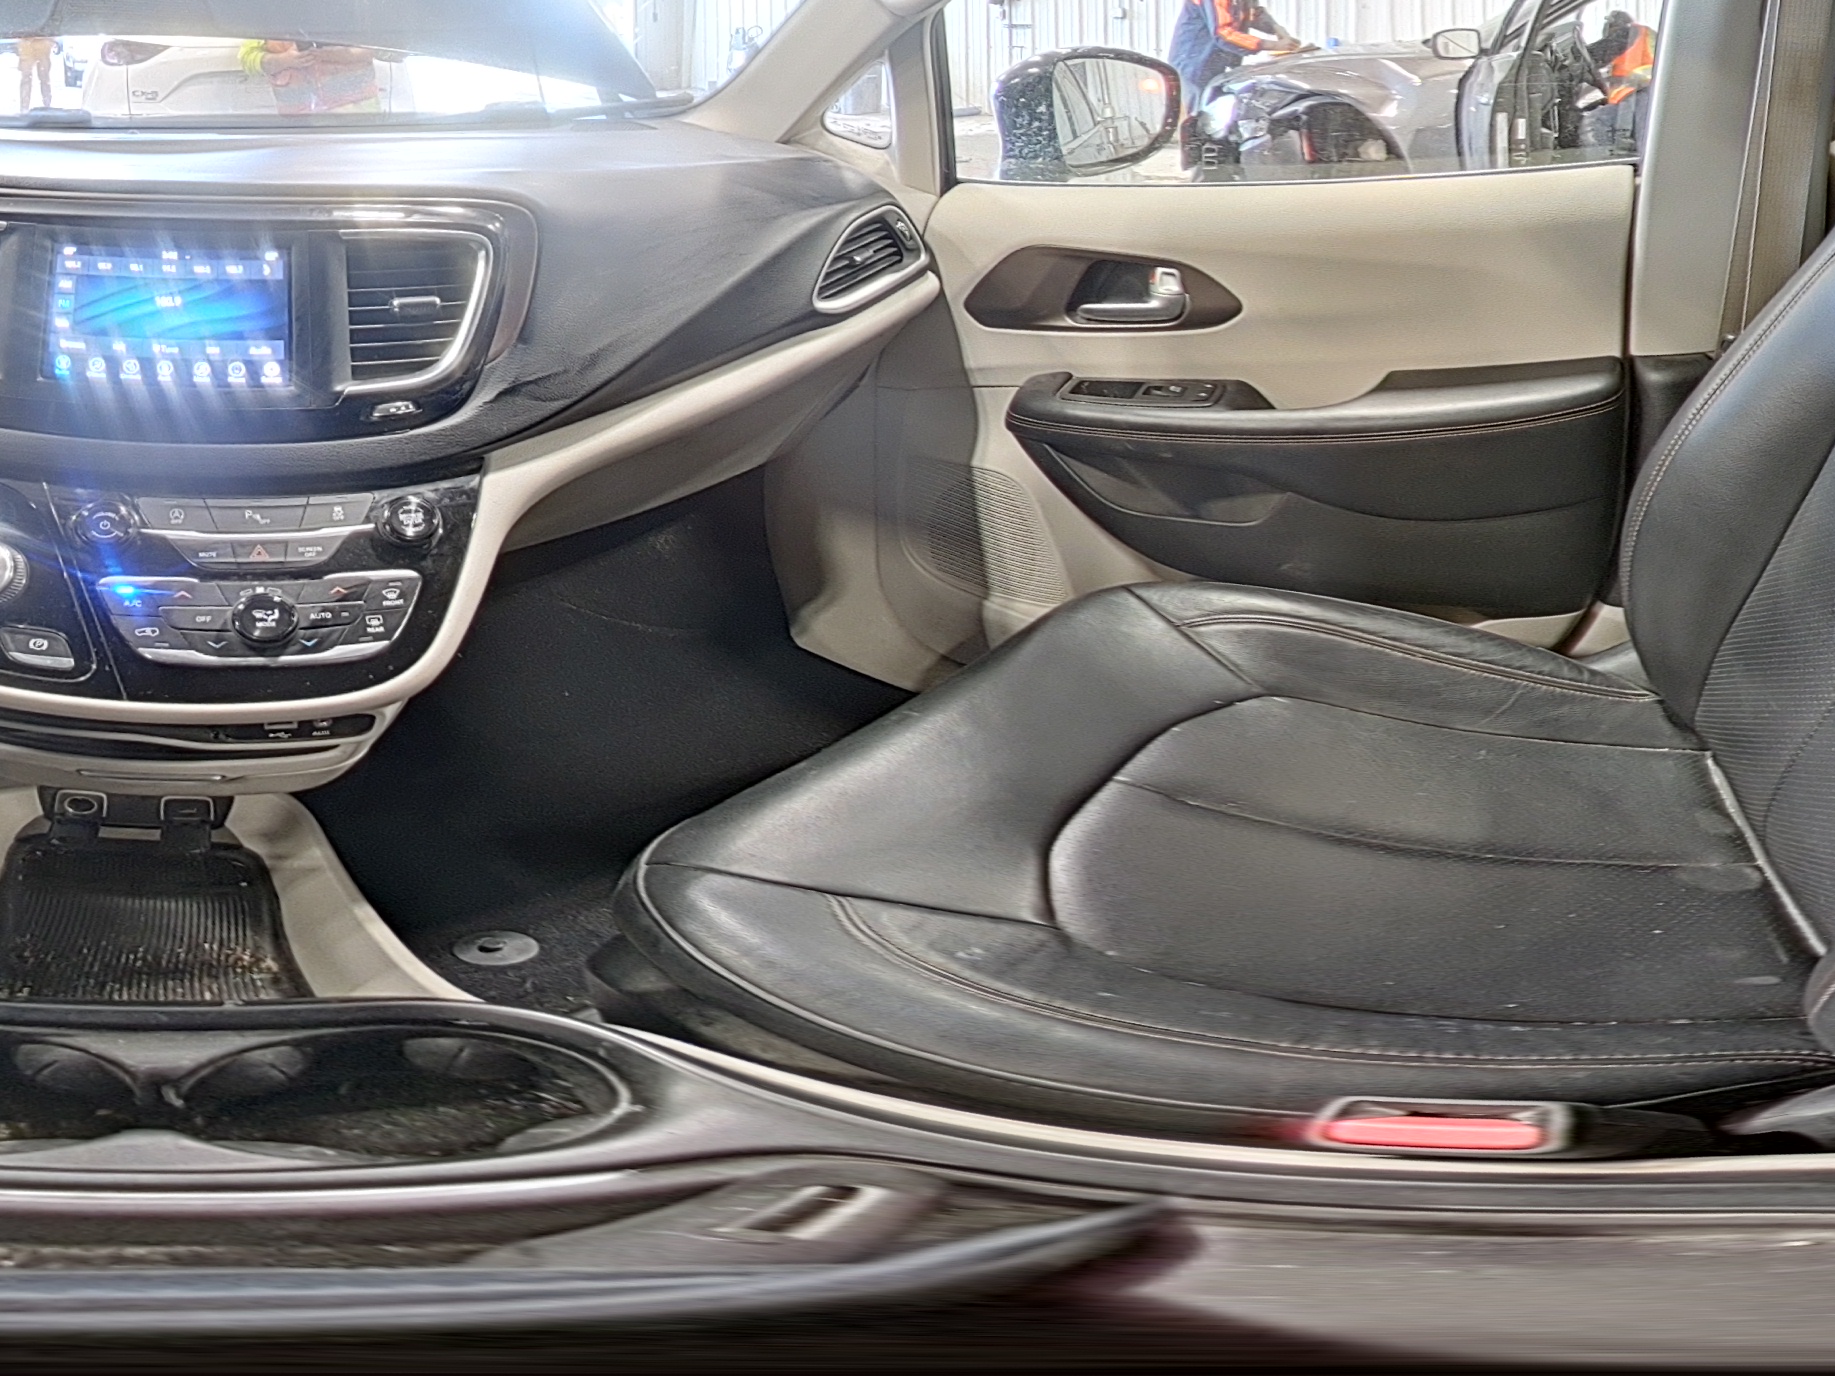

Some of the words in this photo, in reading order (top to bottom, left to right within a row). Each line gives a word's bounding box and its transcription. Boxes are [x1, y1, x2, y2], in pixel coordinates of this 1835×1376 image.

[58, 299, 70, 308] FM
[123, 600, 142, 608] A/C
[195, 615, 212, 623] OFF
[309, 612, 332, 620] AUTO
[366, 625, 385, 633] REAR
